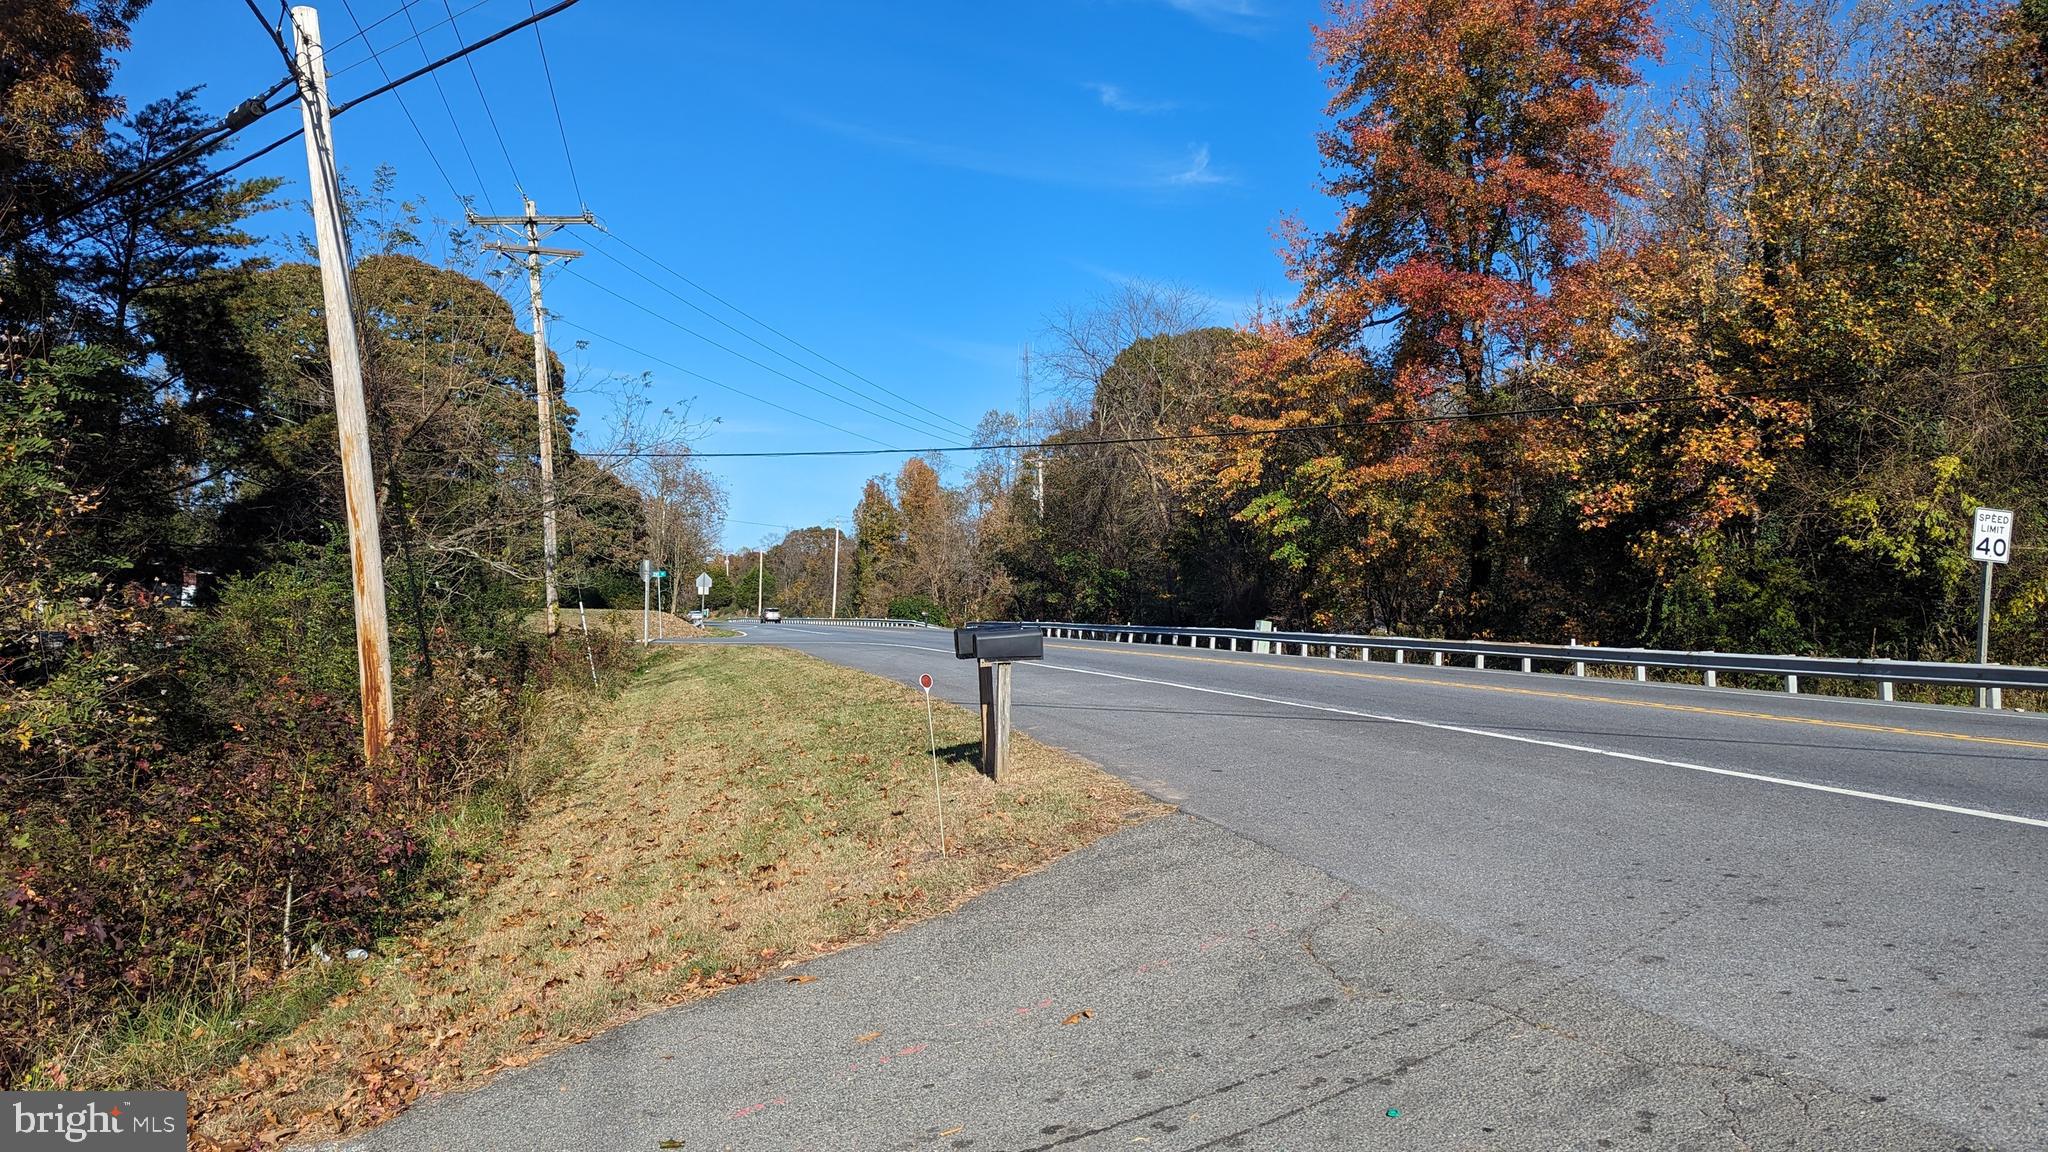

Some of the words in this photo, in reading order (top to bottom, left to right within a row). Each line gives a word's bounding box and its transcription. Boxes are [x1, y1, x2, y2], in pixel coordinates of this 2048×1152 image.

[1979, 514, 2009, 524] SPEED
[1981, 524, 2005, 534] LIMIT
[1976, 537, 2006, 557] 40
